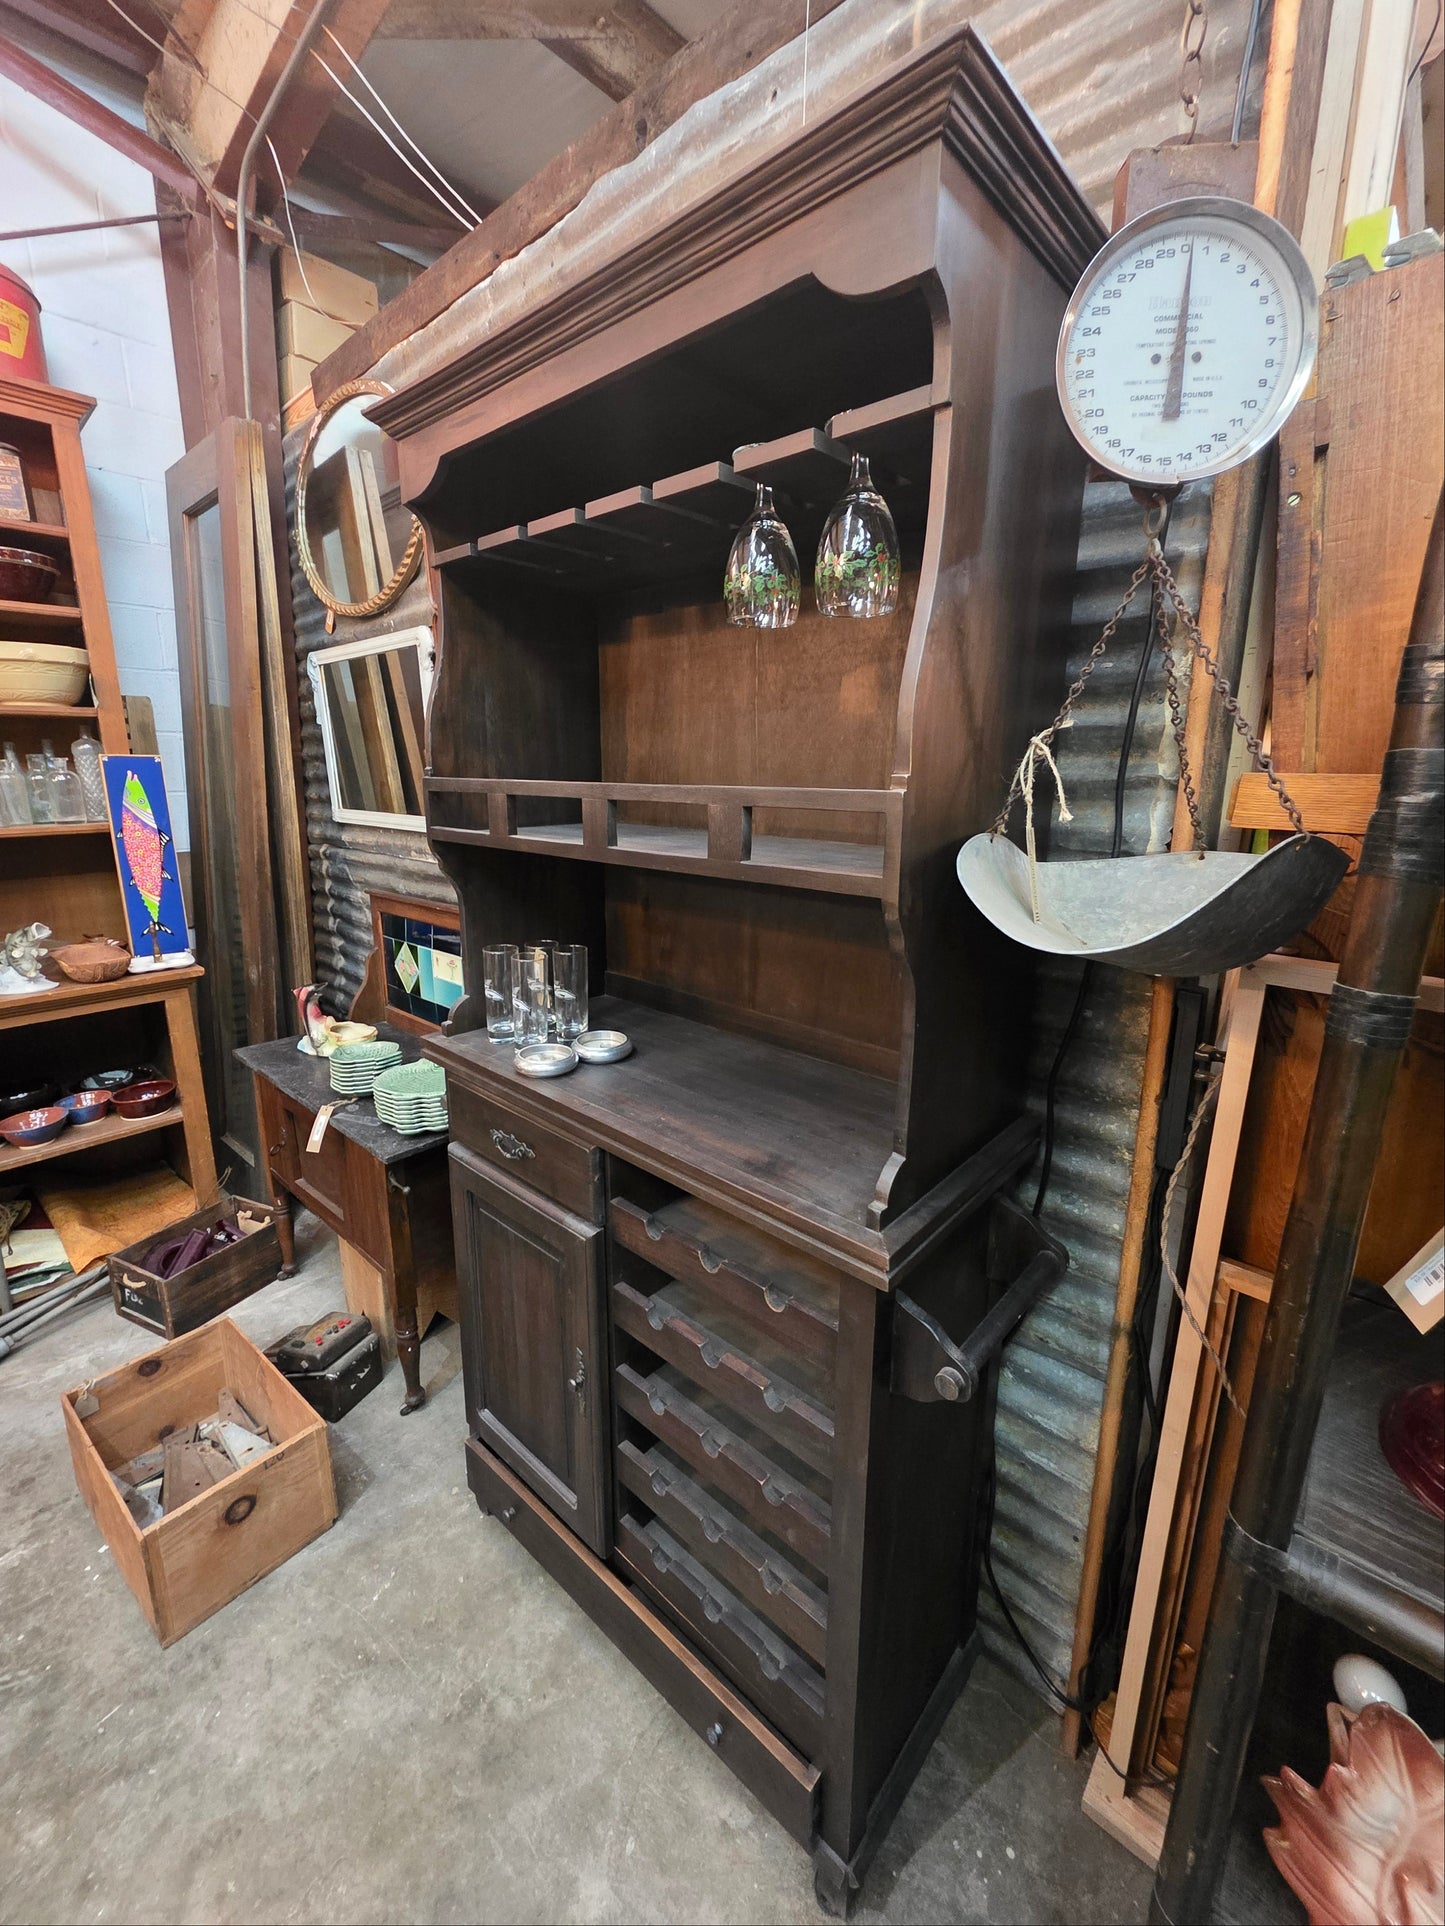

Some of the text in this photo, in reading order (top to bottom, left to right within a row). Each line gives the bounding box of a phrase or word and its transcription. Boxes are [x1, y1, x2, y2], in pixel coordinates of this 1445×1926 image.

[1156, 248, 1176, 259] 29
[1180, 243, 1191, 254] 0
[1202, 245, 1210, 256] 1
[1219, 252, 1231, 263] 2
[1135, 258, 1155, 270] 28
[1236, 263, 1246, 274] 3
[1117, 272, 1137, 284] 27
[1250, 278, 1260, 288] 4
[1102, 289, 1122, 300] 26
[1259, 295, 1269, 305] 5
[1091, 305, 1111, 317] 25
[1153, 312, 1204, 322] COMMCIAL
[1265, 315, 1275, 325] 6
[1082, 326, 1102, 337] 24
[1267, 336, 1277, 346] 7
[1076, 348, 1096, 358] 23
[1264, 358, 1274, 368] 8
[1075, 369, 1095, 380] 22
[1258, 378, 1268, 388] 9
[1077, 388, 1095, 399] 21
[1130, 391, 1213, 402] CAPACITY POUNDS
[1240, 399, 1257, 409] 10
[1085, 408, 1105, 418] 20
[1228, 418, 1243, 428] 11
[1092, 425, 1109, 435] 19
[1211, 432, 1228, 442] 12
[1105, 438, 1122, 448] 18
[1195, 443, 1212, 453] 13
[1119, 448, 1136, 458] 17
[1176, 452, 1193, 462] 14
[1136, 454, 1152, 464] 16
[1156, 456, 1172, 466] 15
